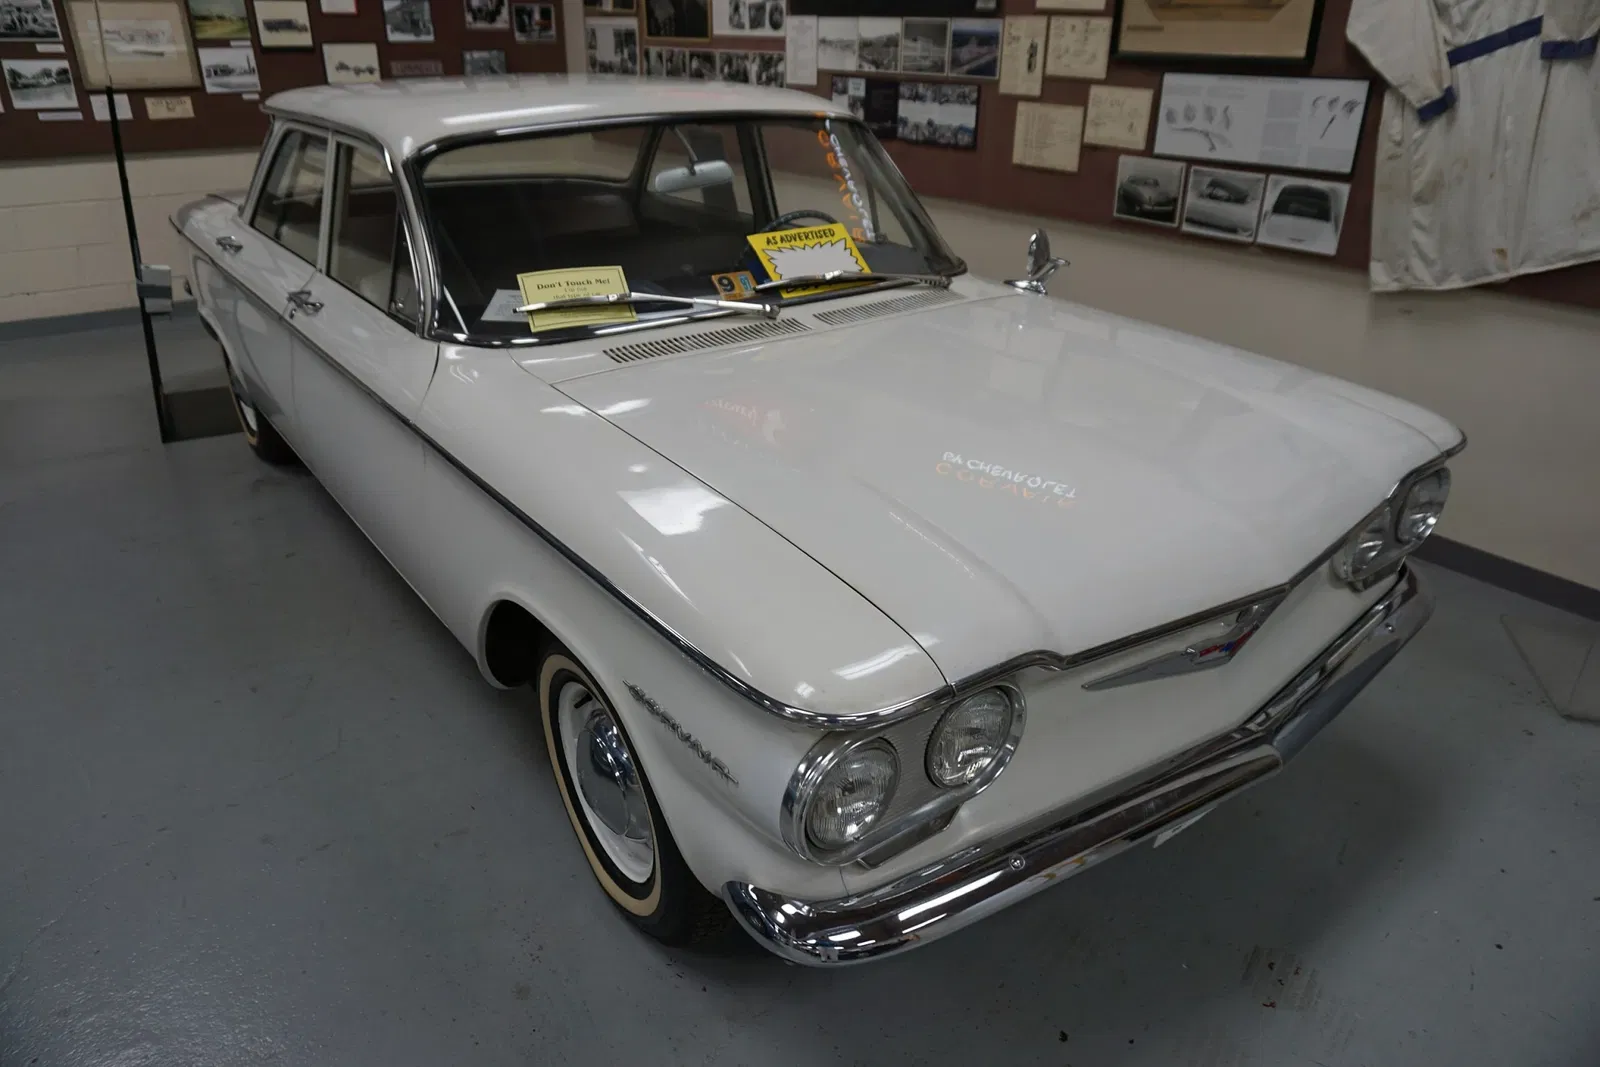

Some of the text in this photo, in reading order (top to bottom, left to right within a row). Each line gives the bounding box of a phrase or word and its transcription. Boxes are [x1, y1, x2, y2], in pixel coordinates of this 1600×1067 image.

[766, 228, 836, 246] AS ADVERTISED
[537, 280, 562, 291] Don't
[565, 279, 593, 287] Touch
